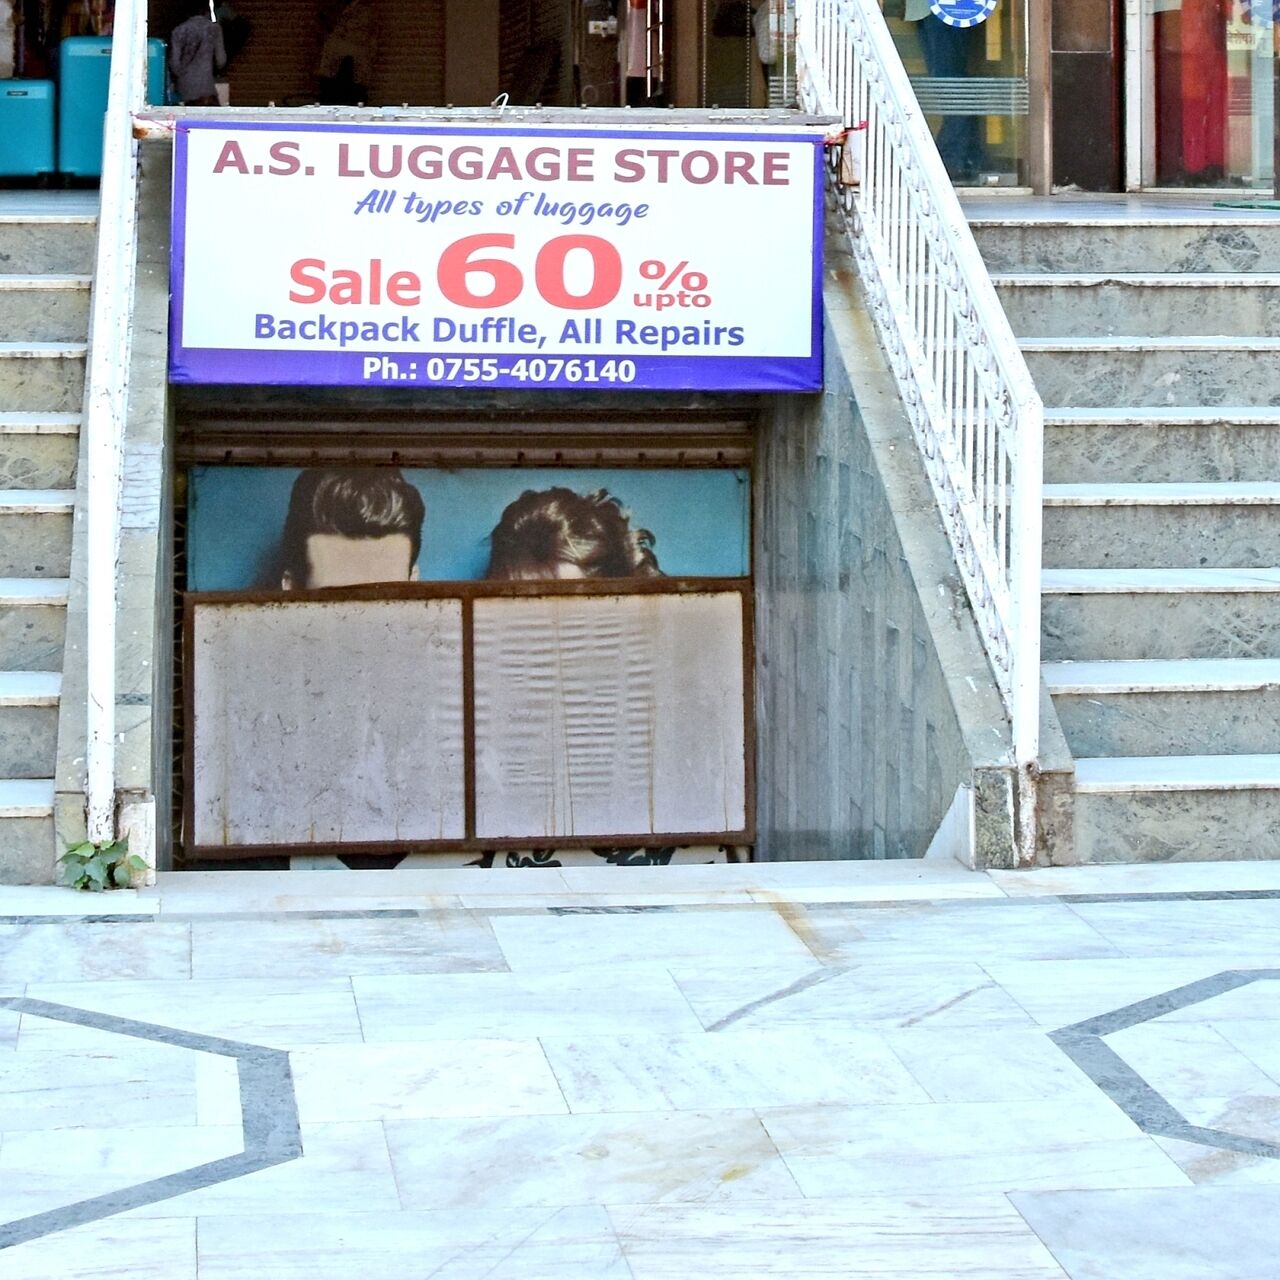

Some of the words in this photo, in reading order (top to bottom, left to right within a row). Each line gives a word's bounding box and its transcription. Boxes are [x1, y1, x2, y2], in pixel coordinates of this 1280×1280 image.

[212, 139, 315, 176] A.S.
[338, 142, 595, 183] LUGGAGE
[613, 148, 791, 187] STORE
[353, 188, 400, 216] All
[402, 191, 483, 223] types
[494, 191, 529, 218] of
[532, 192, 650, 227] luggage
[287, 256, 422, 308] Sale
[435, 232, 623, 310] 60
[637, 259, 709, 291] %
[632, 291, 713, 313] upto
[253, 312, 420, 344] Backpack
[431, 315, 547, 349] Duffle,
[558, 318, 604, 344] All
[613, 319, 745, 350] Repairs
[362, 356, 417, 380] Ph.:
[426, 357, 637, 384] 0755-4076140
